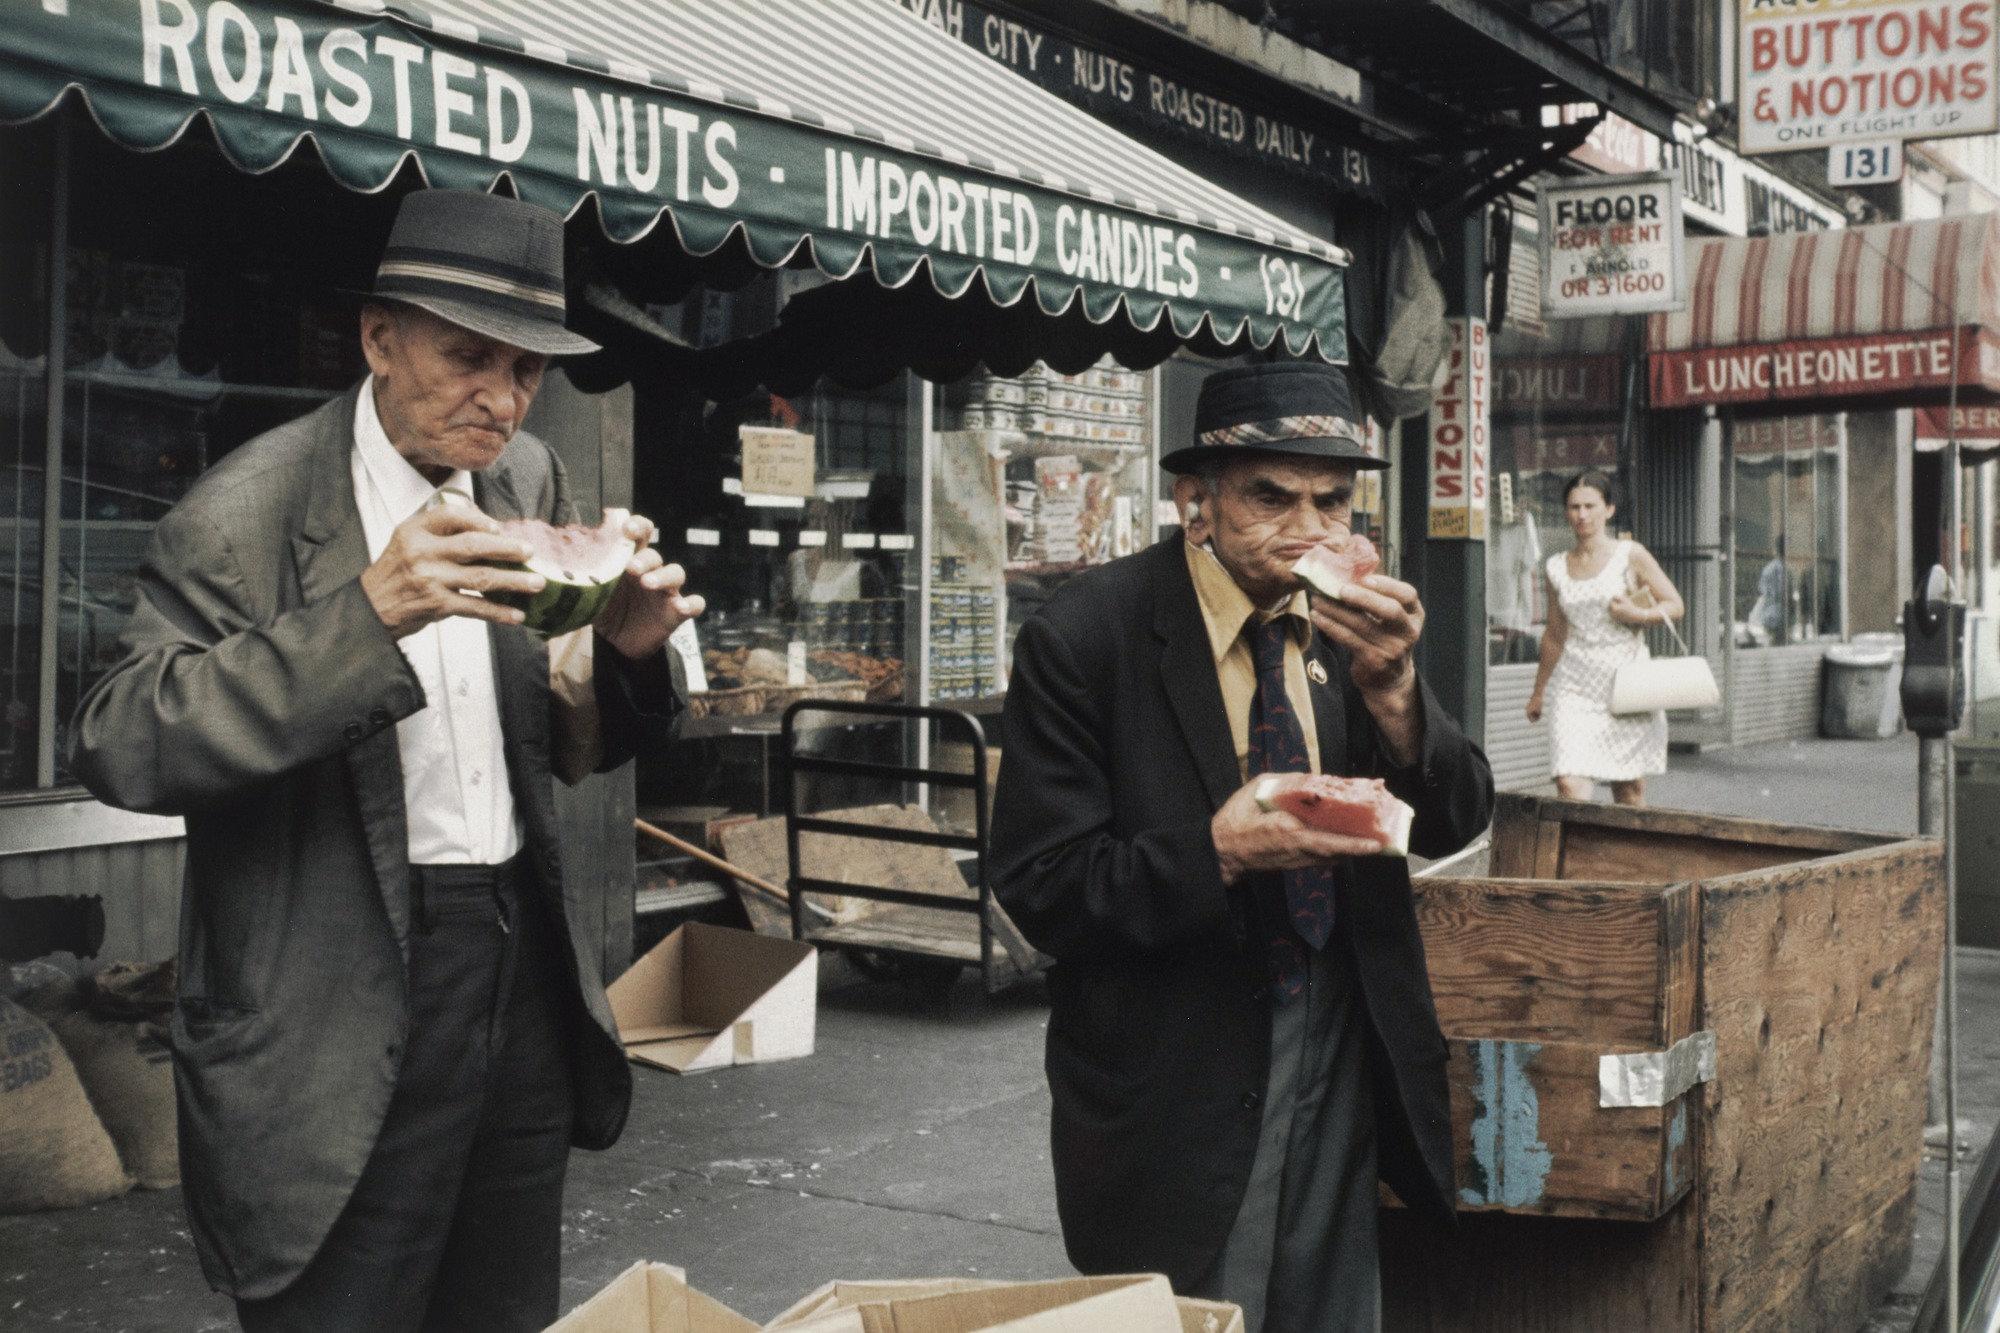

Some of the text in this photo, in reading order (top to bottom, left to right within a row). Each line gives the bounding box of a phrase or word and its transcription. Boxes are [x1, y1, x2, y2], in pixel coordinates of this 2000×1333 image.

[1752, 3, 1989, 72] BUTTONS
[984, 14, 1042, 71] CITY
[1074, 48, 1134, 102] NUTS
[1150, 75, 1246, 143] ROASTED
[1255, 116, 1314, 165] DAILY
[1343, 146, 1370, 185] 131
[1754, 62, 1988, 123] & NOTIONS
[1778, 110, 1962, 142] ONE FLIGHT UP
[141, 0, 1305, 322] ROASTED NUTS IMPORTED CANDIES 131
[1845, 147, 1891, 178] 131
[1557, 194, 1659, 226] FLOOR
[1558, 225, 1661, 250] FOR RENT
[1685, 339, 1951, 394] LUNCHEONETTE
[1472, 326, 1485, 498] BUTTONS
